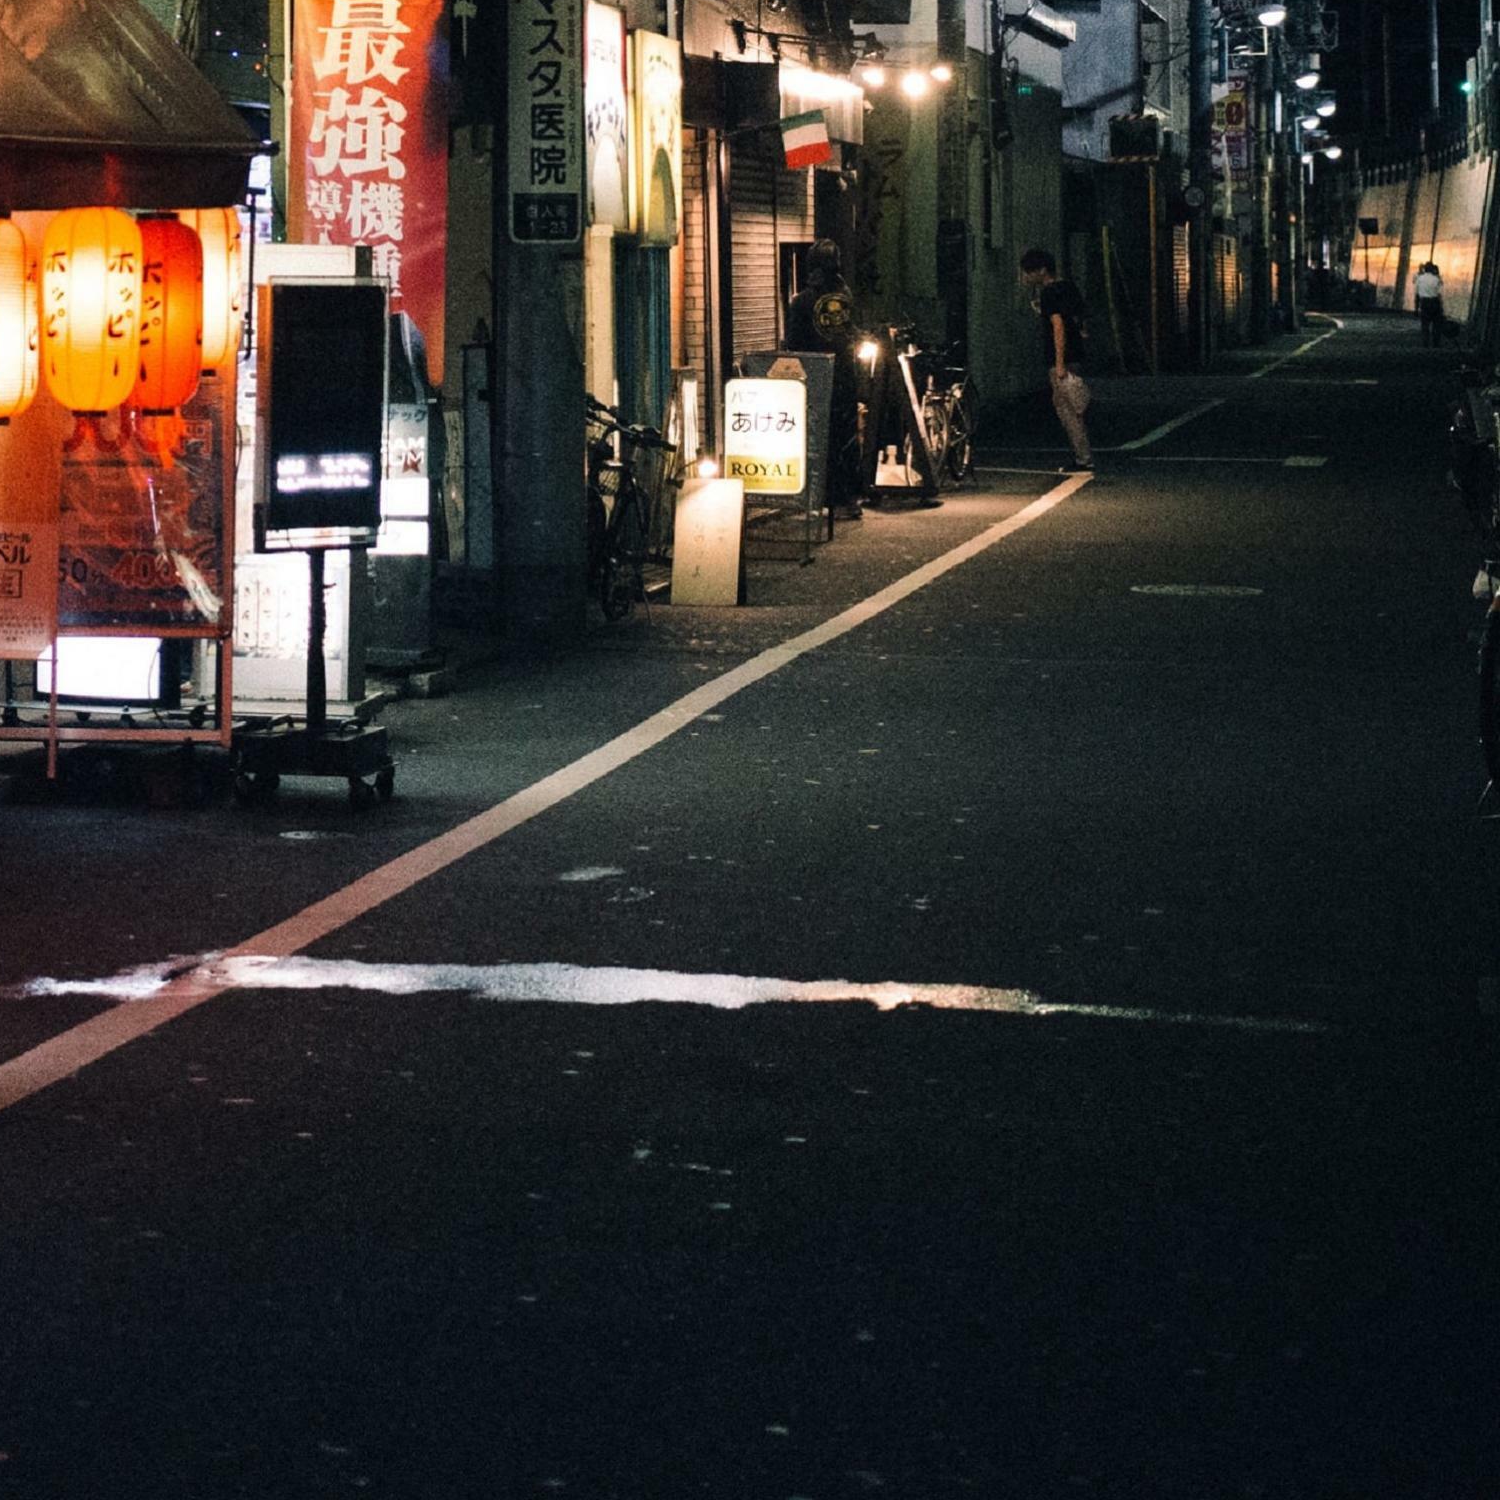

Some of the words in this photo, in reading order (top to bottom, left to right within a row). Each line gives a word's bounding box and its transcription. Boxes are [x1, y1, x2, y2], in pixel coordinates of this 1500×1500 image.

[106, 249, 135, 378] ホッピー
[731, 411, 796, 433] あけみ
[731, 462, 797, 476] ROYAL
